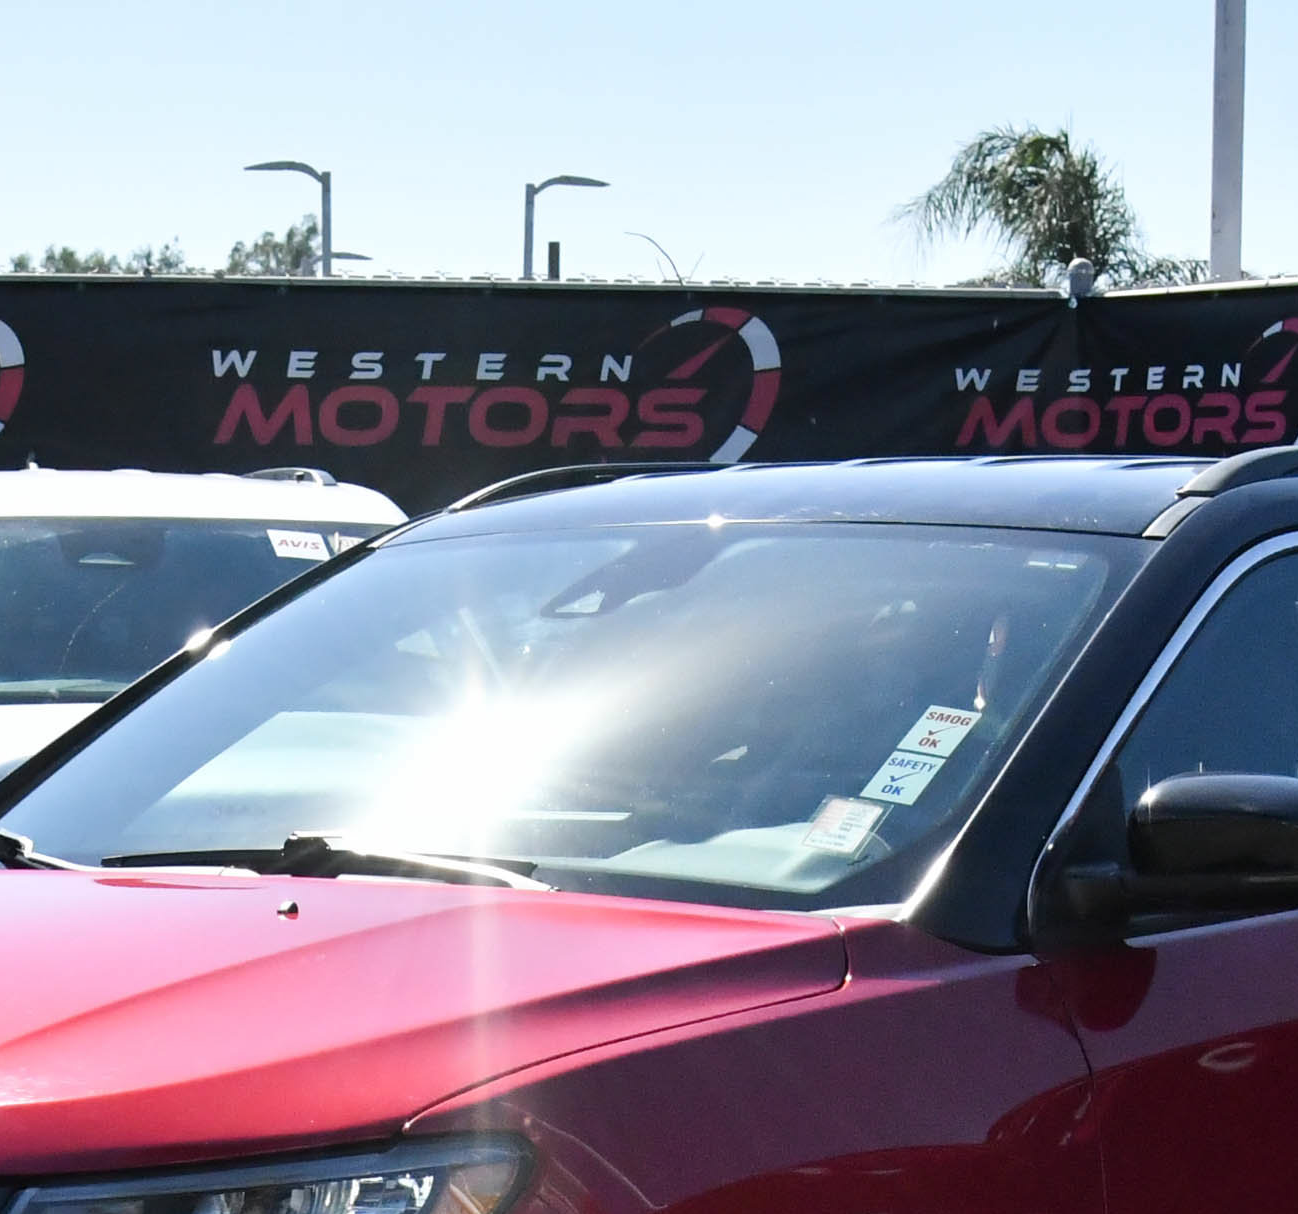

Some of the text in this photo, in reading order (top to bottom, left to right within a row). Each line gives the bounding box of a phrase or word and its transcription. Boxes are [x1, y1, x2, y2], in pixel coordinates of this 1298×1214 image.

[212, 349, 633, 383] WESTERN
[954, 362, 1242, 393] WESTERN
[213, 383, 708, 448] MOTORS
[955, 389, 1288, 448] MOTORS
[277, 538, 321, 550] AVIS
[926, 711, 972, 727] SMOG
[918, 736, 942, 749] OK
[888, 757, 937, 772] SAFETY
[880, 783, 905, 796] OK
